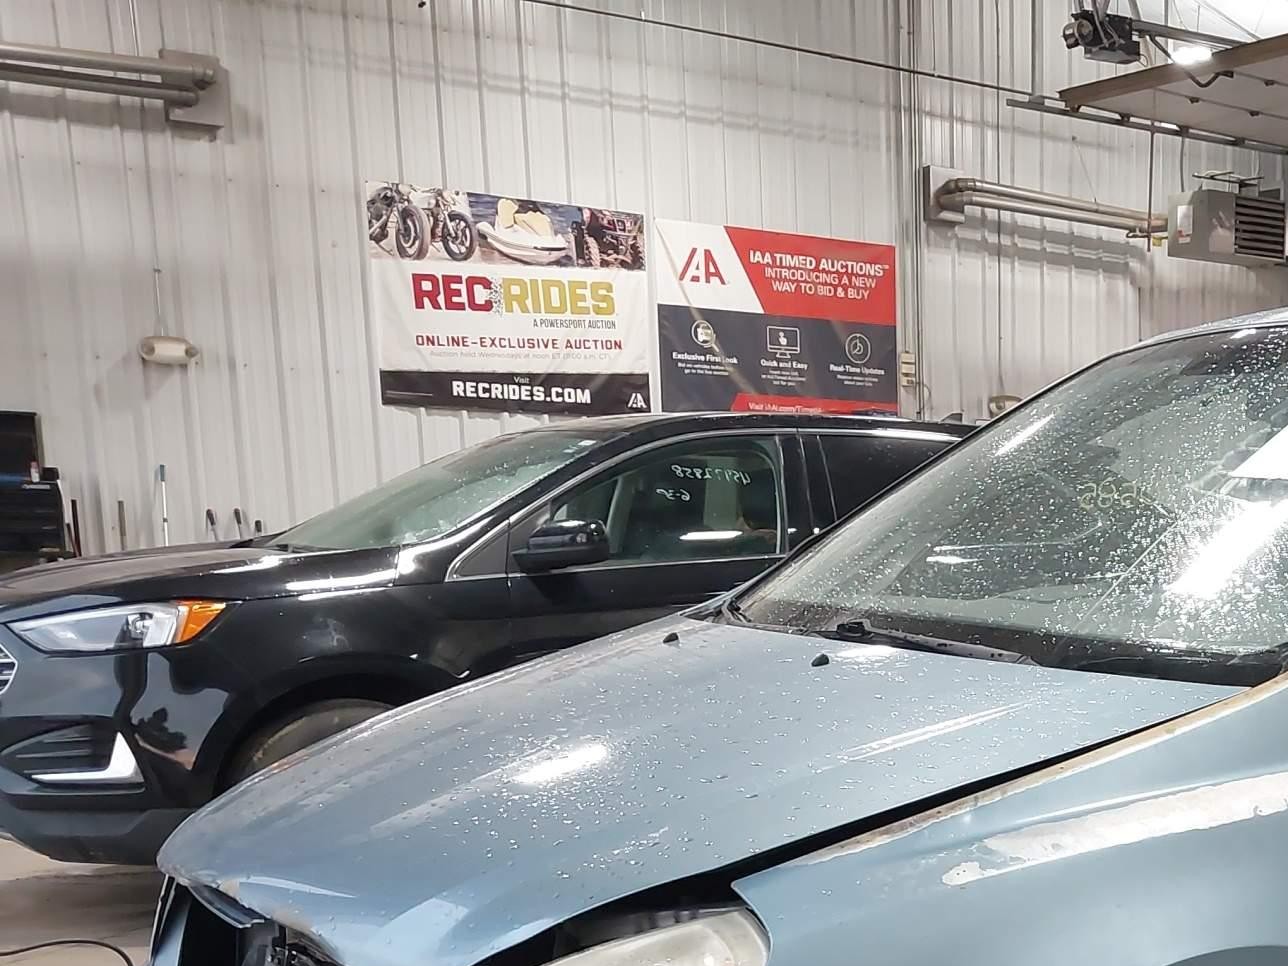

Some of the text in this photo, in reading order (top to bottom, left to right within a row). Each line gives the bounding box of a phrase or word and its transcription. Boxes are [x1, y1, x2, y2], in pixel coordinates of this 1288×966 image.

[749, 250, 772, 265] IAA
[774, 253, 816, 269] TIMED
[764, 267, 876, 288] INTRODUCING A NEW
[411, 273, 616, 316] REC RIDES
[771, 280, 870, 300] WAY TO BID & BUY
[533, 318, 616, 329] A POWERSPORT AUCTION
[415, 335, 623, 350] ONLINE-EXCLUSIVE AUCTION
[672, 351, 705, 361] Exclusive
[513, 376, 530, 384] Visit
[452, 380, 591, 404] RECRIDES.COM
